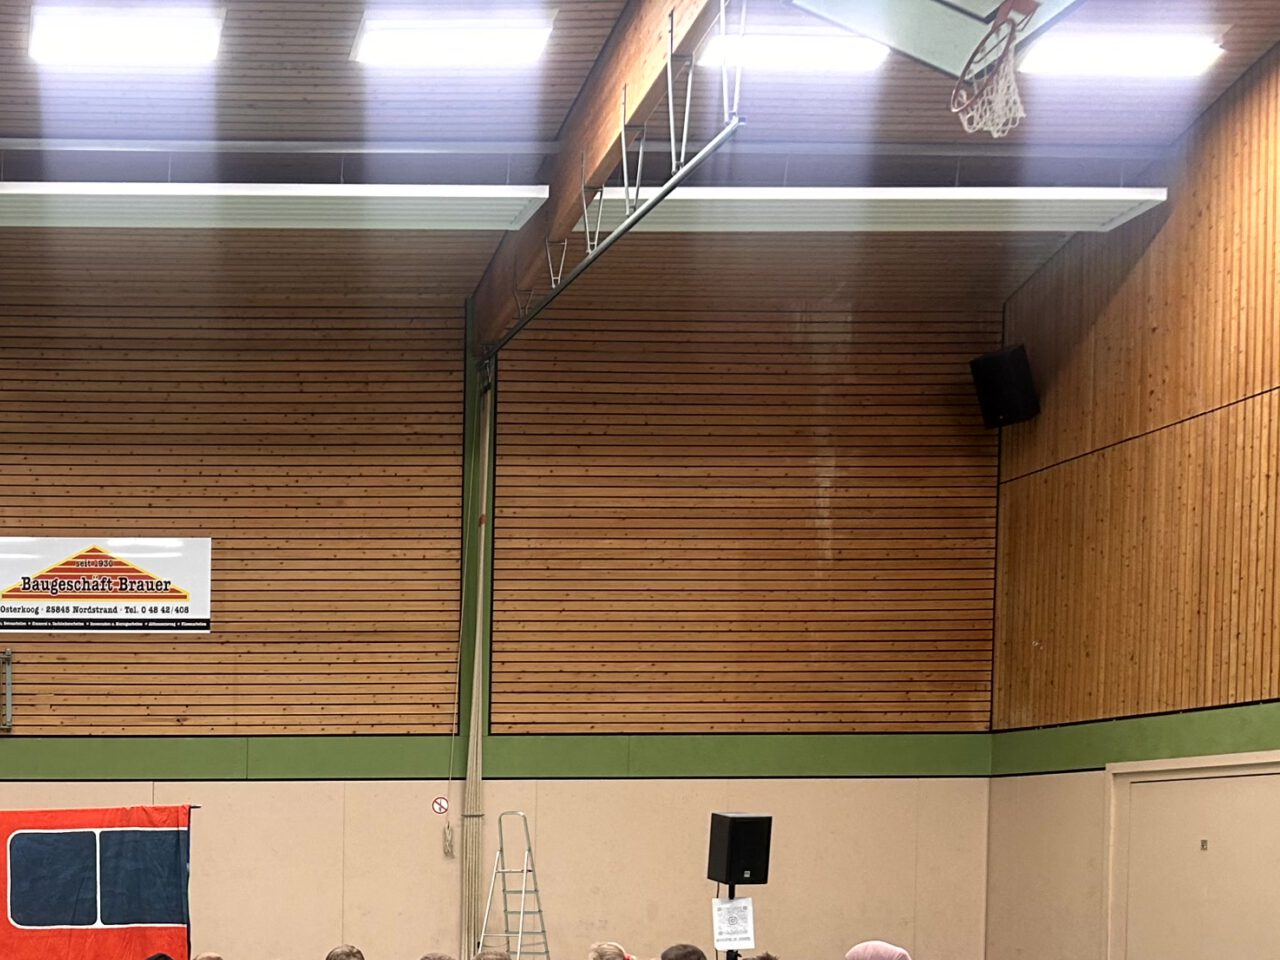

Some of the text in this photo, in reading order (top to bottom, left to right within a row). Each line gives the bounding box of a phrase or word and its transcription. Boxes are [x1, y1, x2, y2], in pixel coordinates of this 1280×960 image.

[76, 560, 114, 568] seit 1930
[21, 576, 172, 595] Baugeschäft Brauer
[0, 606, 40, 615] Osterkoog
[46, 606, 70, 614] 25845
[72, 606, 118, 614] Nordstrand
[124, 606, 138, 614] Tel.
[141, 606, 146, 614] 0
[148, 606, 158, 614] 48
